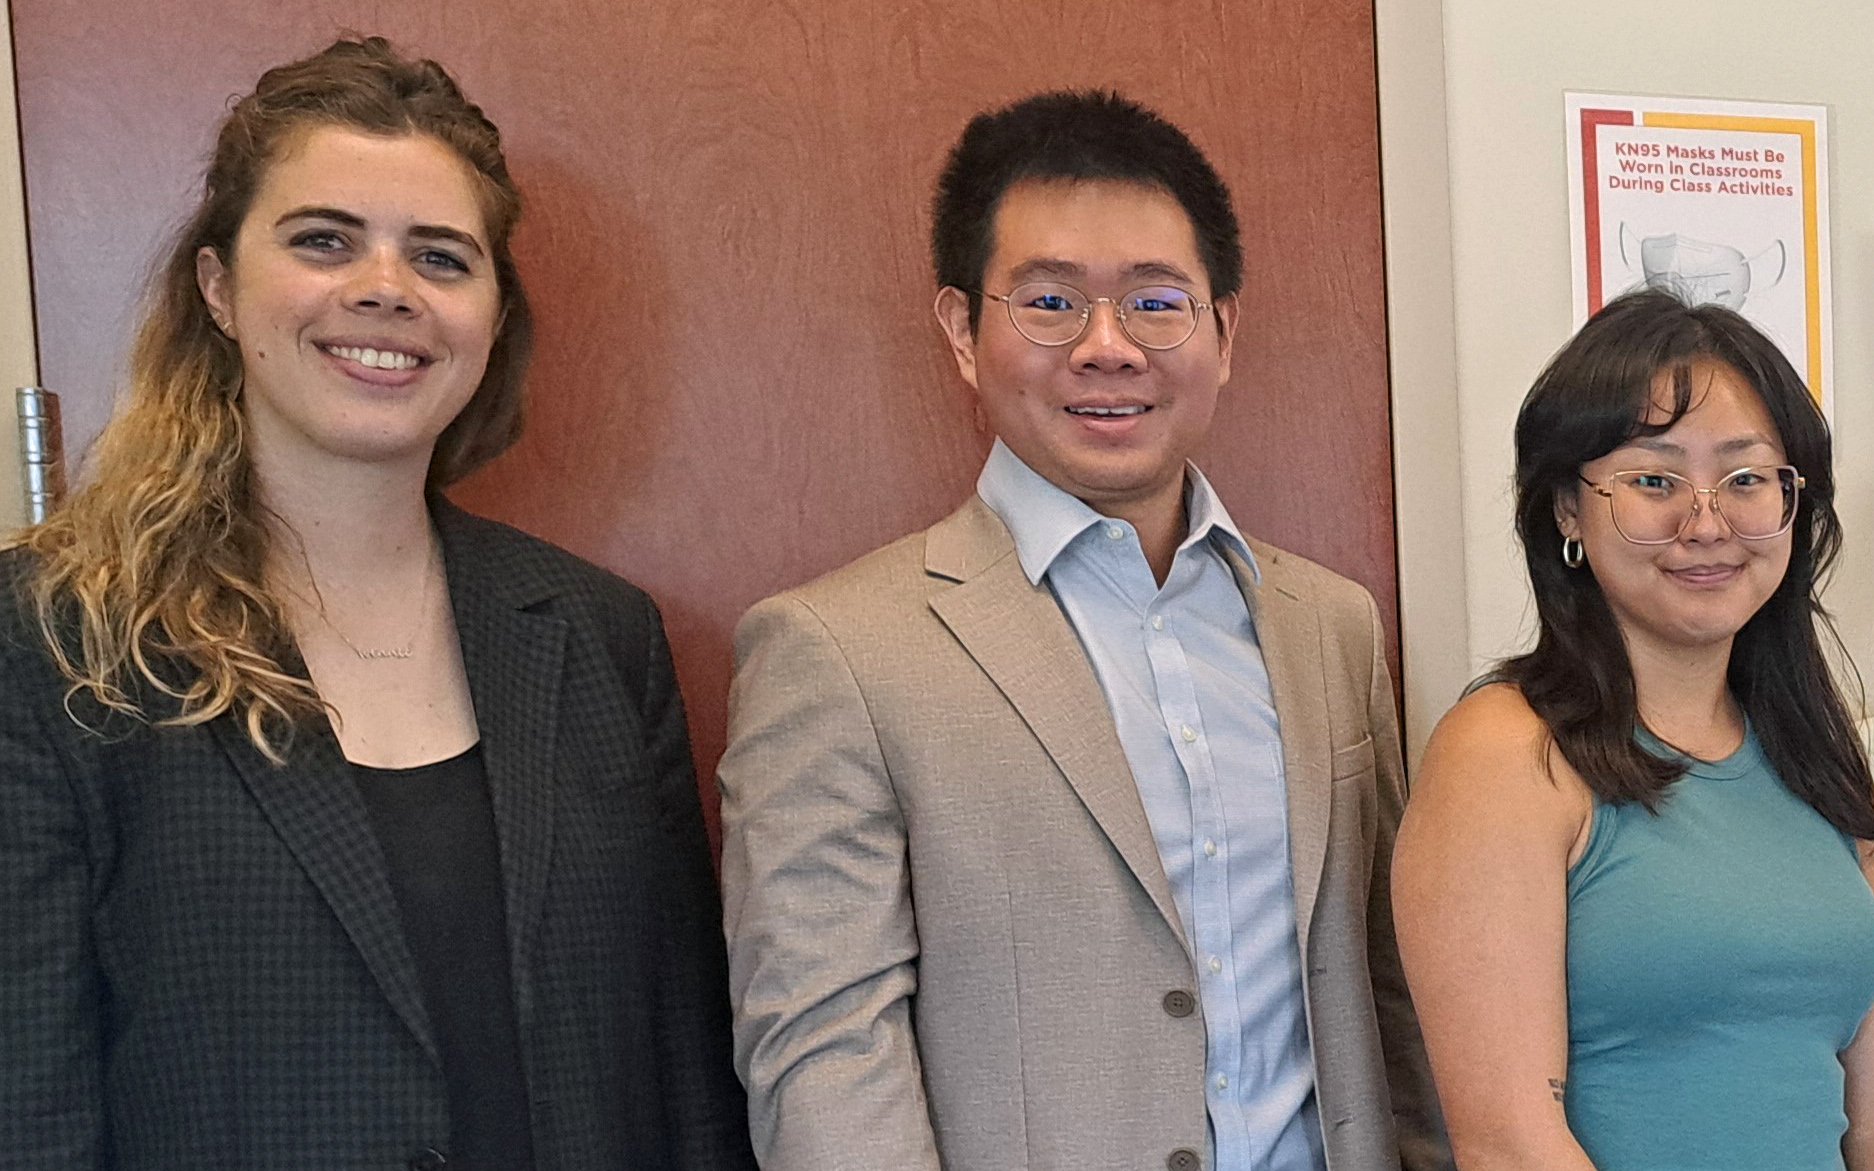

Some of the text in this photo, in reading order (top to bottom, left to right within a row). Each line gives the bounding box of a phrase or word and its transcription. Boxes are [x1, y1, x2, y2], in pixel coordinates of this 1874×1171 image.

[1615, 142, 1785, 163] KN95 Masks Must Be
[1619, 159, 1664, 174] Worn
[1690, 163, 1783, 179] Classrooms
[1609, 175, 1793, 197] During Class Activities
